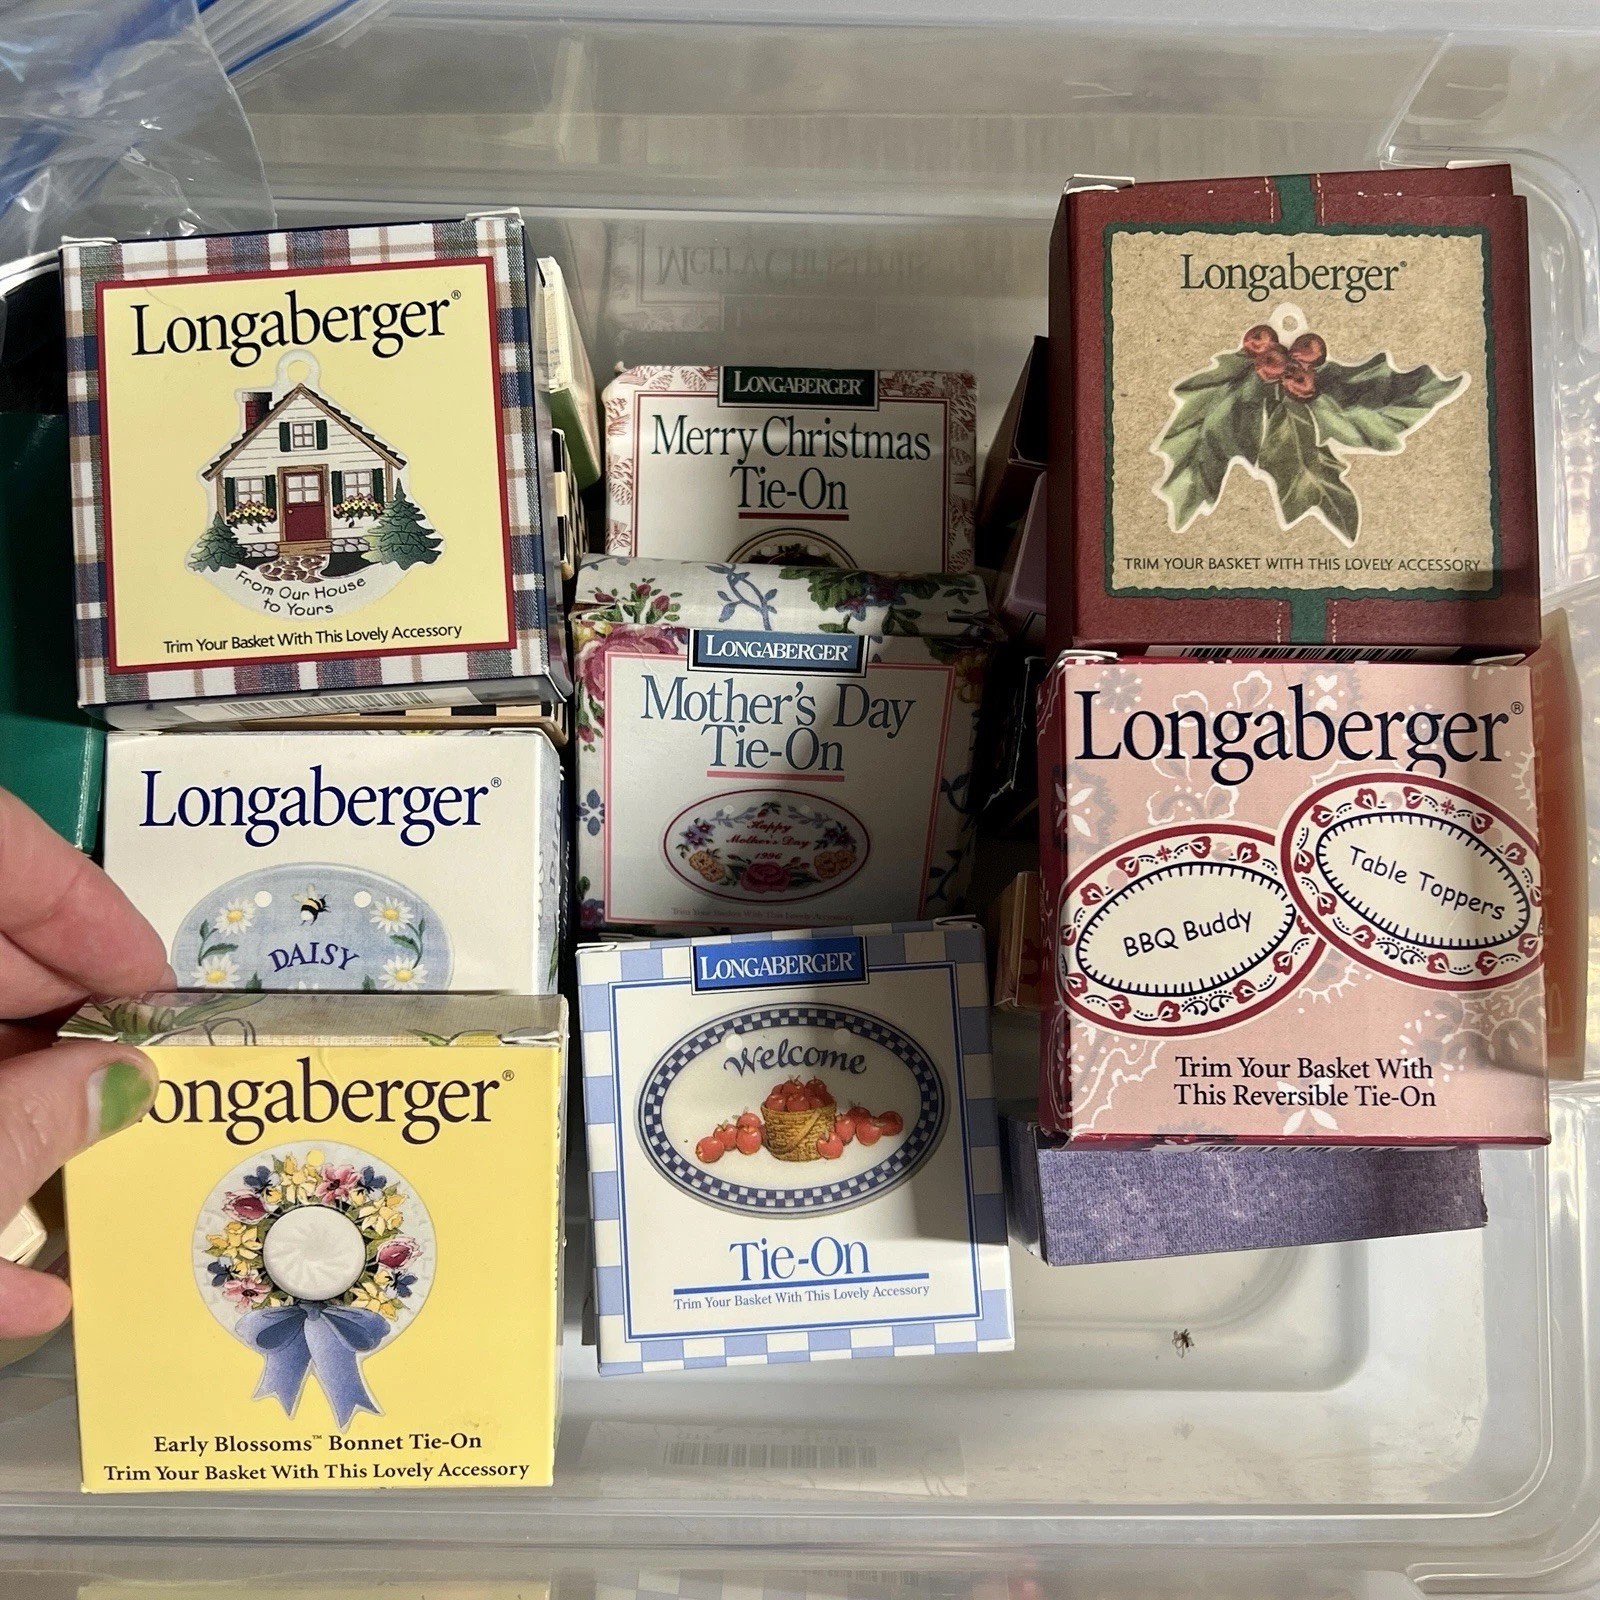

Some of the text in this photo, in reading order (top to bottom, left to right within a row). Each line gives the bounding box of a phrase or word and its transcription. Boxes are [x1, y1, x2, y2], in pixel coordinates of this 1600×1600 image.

[734, 370, 863, 396] LONGABERGER
[651, 413, 931, 464] Merry Christmas
[731, 465, 849, 511] Tie-On
[1124, 558, 1481, 572] TRIM YOUR BASKET WITH THIS LOVELY ACCESSORY
[235, 570, 367, 600] From Our House
[263, 599, 334, 616] to Yours
[163, 624, 462, 654] Trim Your Basket With This Lovely Accessory
[705, 634, 849, 663] LONGABERGER
[641, 674, 917, 739] Mother's Day
[701, 722, 844, 772] Tie-On
[747, 820, 792, 833] Happy
[755, 852, 783, 860] 1996
[781, 836, 811, 849] Day
[1350, 846, 1506, 921] Table Toppers
[1123, 908, 1253, 957] BBQ Buddy
[268, 941, 360, 973] DAISY
[700, 951, 854, 981] LONGABERGER
[723, 1039, 868, 1077] Welcome
[1175, 1057, 1434, 1080] Trim Your Basket With
[147, 1056, 515, 1145] ongaberger®
[1173, 1084, 1437, 1108] This Reversible Tie-On
[729, 1236, 870, 1281] Tie-On
[673, 1284, 930, 1310] Trim Your Basket With This Lovely Accessory
[154, 1436, 209, 1457] Early
[328, 1434, 403, 1451] Bonnet
[409, 1433, 482, 1450] Tie-On
[104, 1463, 530, 1481] Trim Your Basket With This Lovely Accessory
